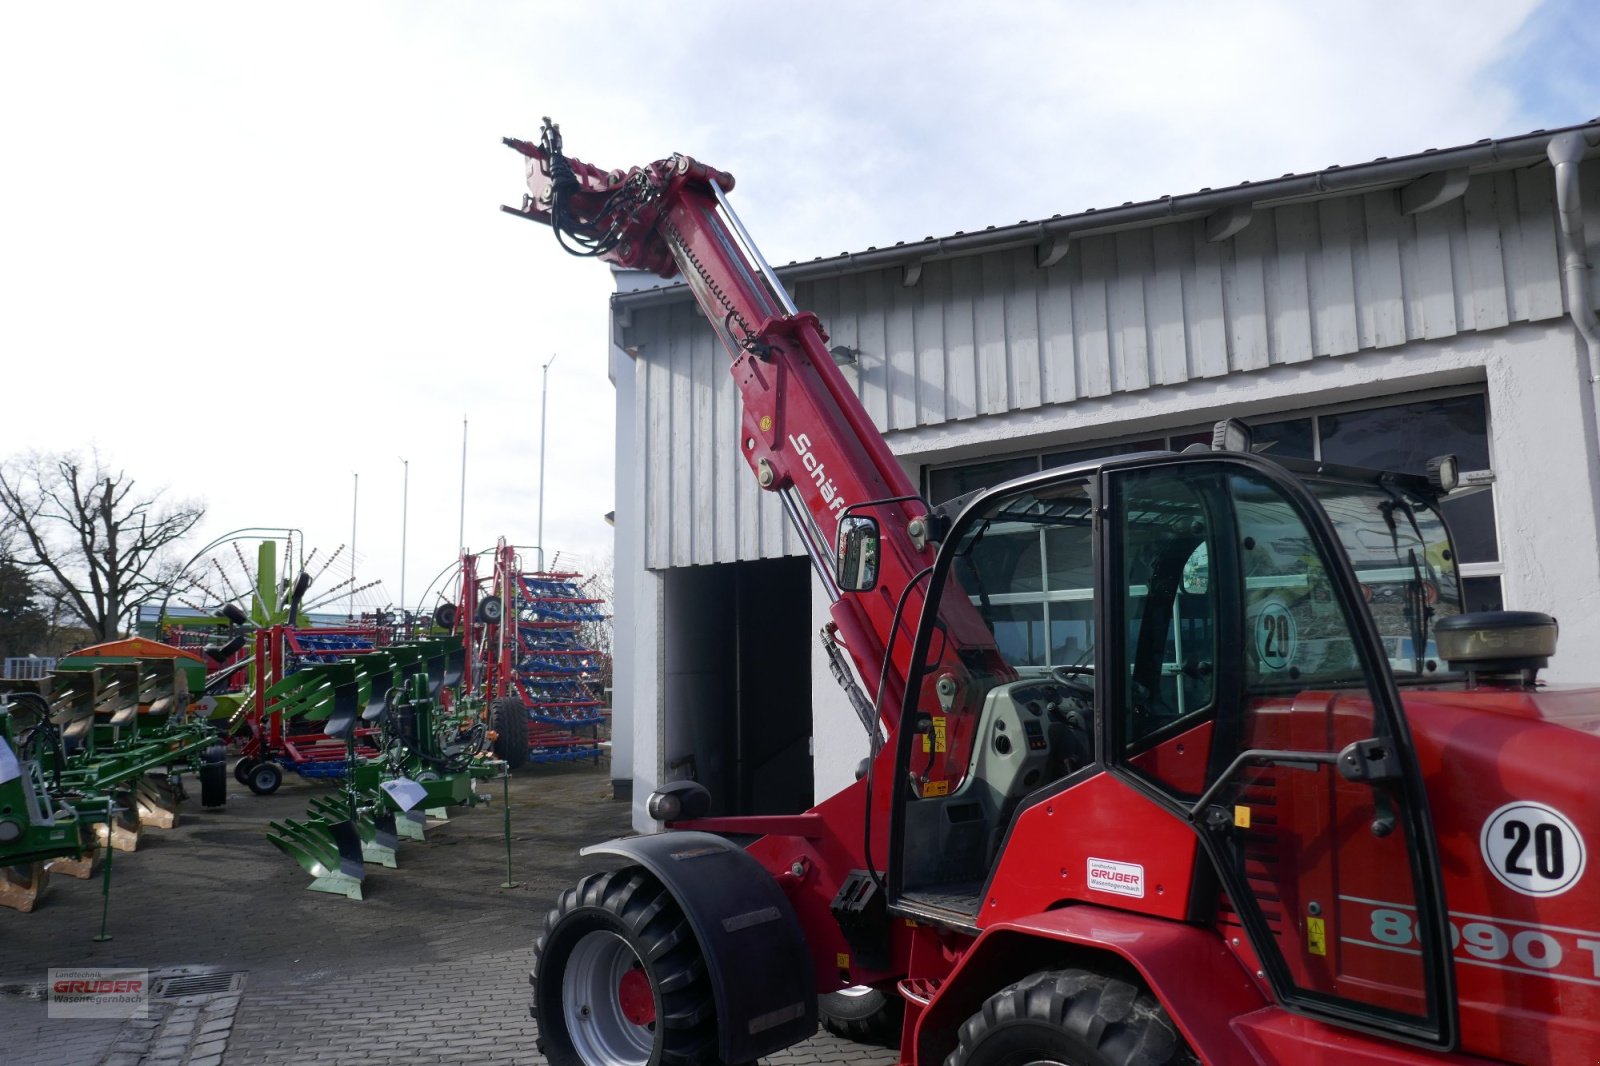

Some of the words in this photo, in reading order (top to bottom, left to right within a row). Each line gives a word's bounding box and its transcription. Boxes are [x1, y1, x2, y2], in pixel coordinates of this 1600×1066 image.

[1264, 614, 1289, 658] 20
[1504, 820, 1565, 880] 20
[1091, 869, 1140, 885] GRUBER
[1370, 909, 1563, 969] 890
